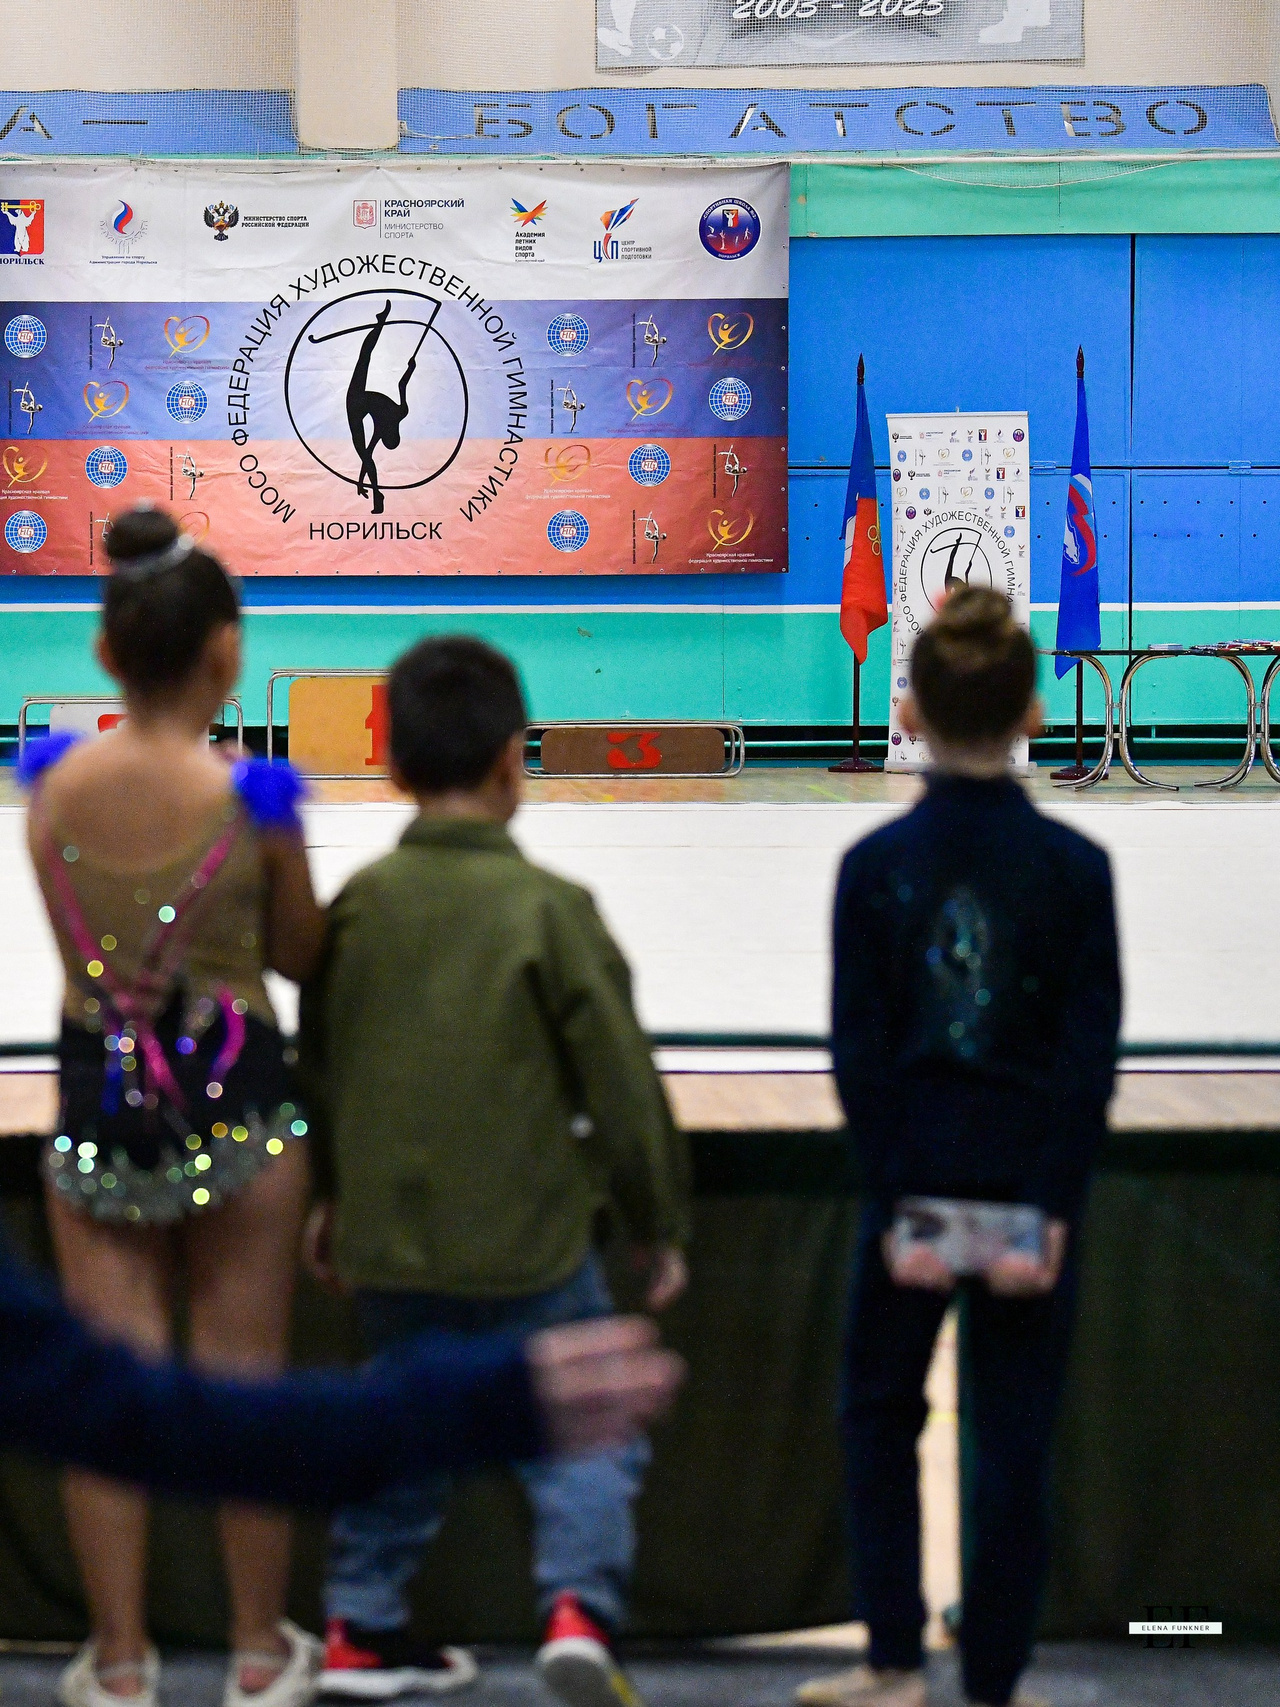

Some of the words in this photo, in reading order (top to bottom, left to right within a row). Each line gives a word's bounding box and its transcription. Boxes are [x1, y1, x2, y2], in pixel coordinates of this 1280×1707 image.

[472, 101, 1208, 140] БОГАТСТВО
[384, 198, 465, 208] КРАСНОЯРСКИЙ
[384, 208, 411, 218] КРАЙ
[288, 254, 517, 352] ХУДОЖЕСТВЕННОЙ
[228, 294, 291, 446] ФЕДЕРАЦИЯ
[459, 356, 528, 522] ГИМНАСТИКИ
[239, 454, 296, 523] МОССО
[309, 522, 443, 541] НОРИЛЬСК
[898, 529, 923, 602] ФЕДЕРАЦИЯ
[922, 510, 1012, 559] ХУДОЖЕСТВЕННОЙ
[1004, 560, 1017, 603] ГИМНА
[606, 731, 663, 769] 3
